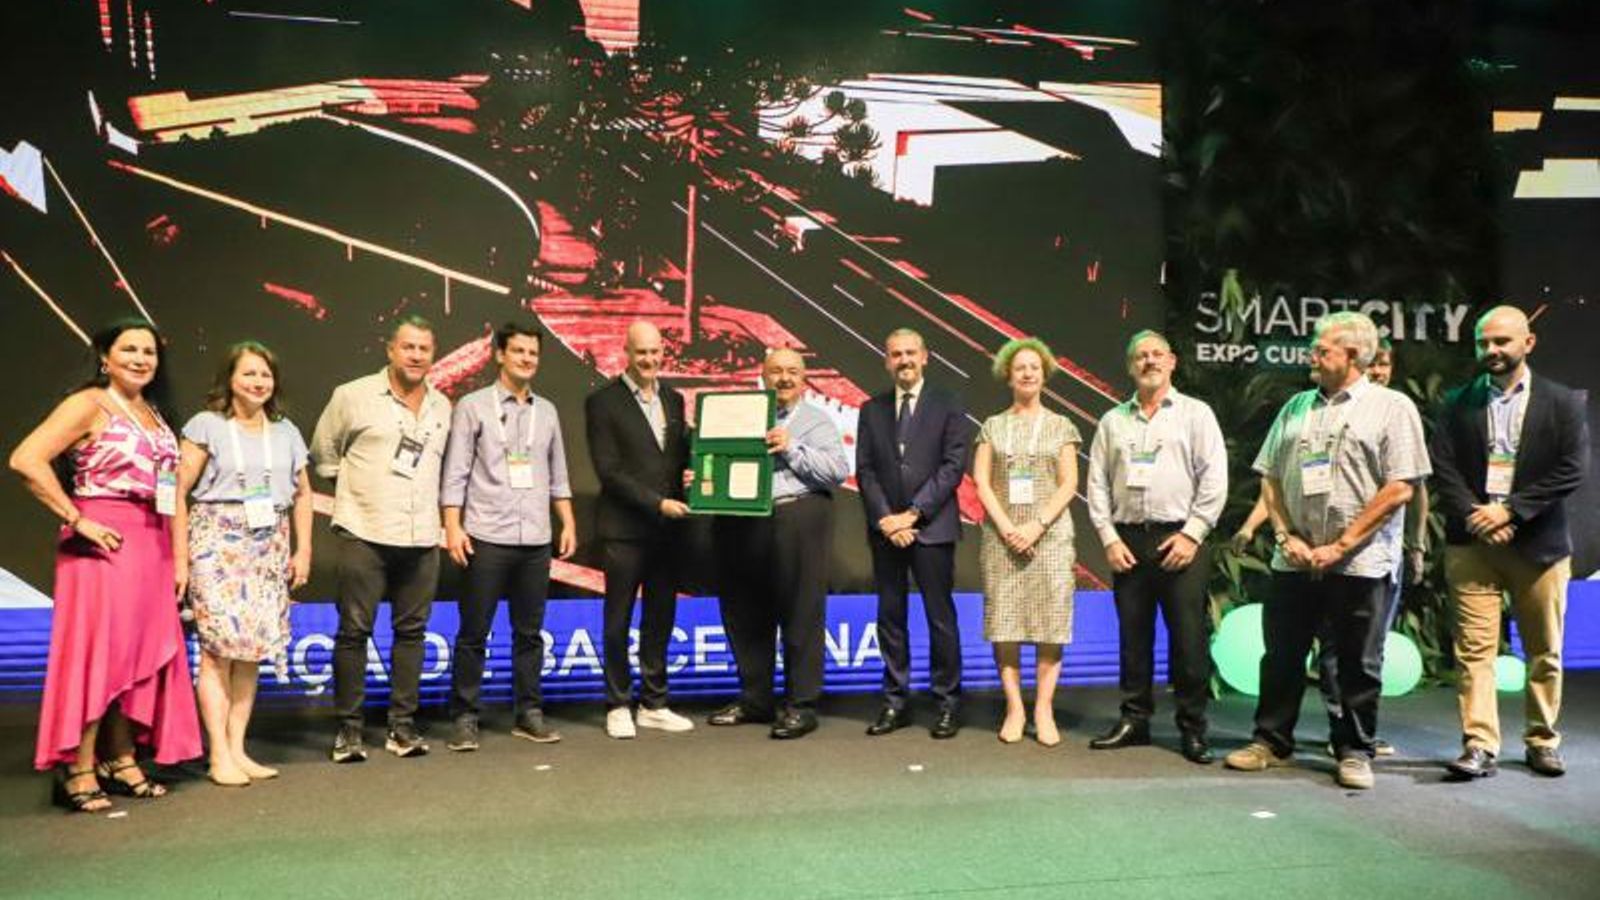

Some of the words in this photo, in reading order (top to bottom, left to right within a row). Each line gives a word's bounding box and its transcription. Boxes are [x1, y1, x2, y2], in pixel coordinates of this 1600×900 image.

[1196, 343, 1259, 363] EXPO
[1264, 344, 1312, 366] CUR
[421, 631, 493, 681] D
